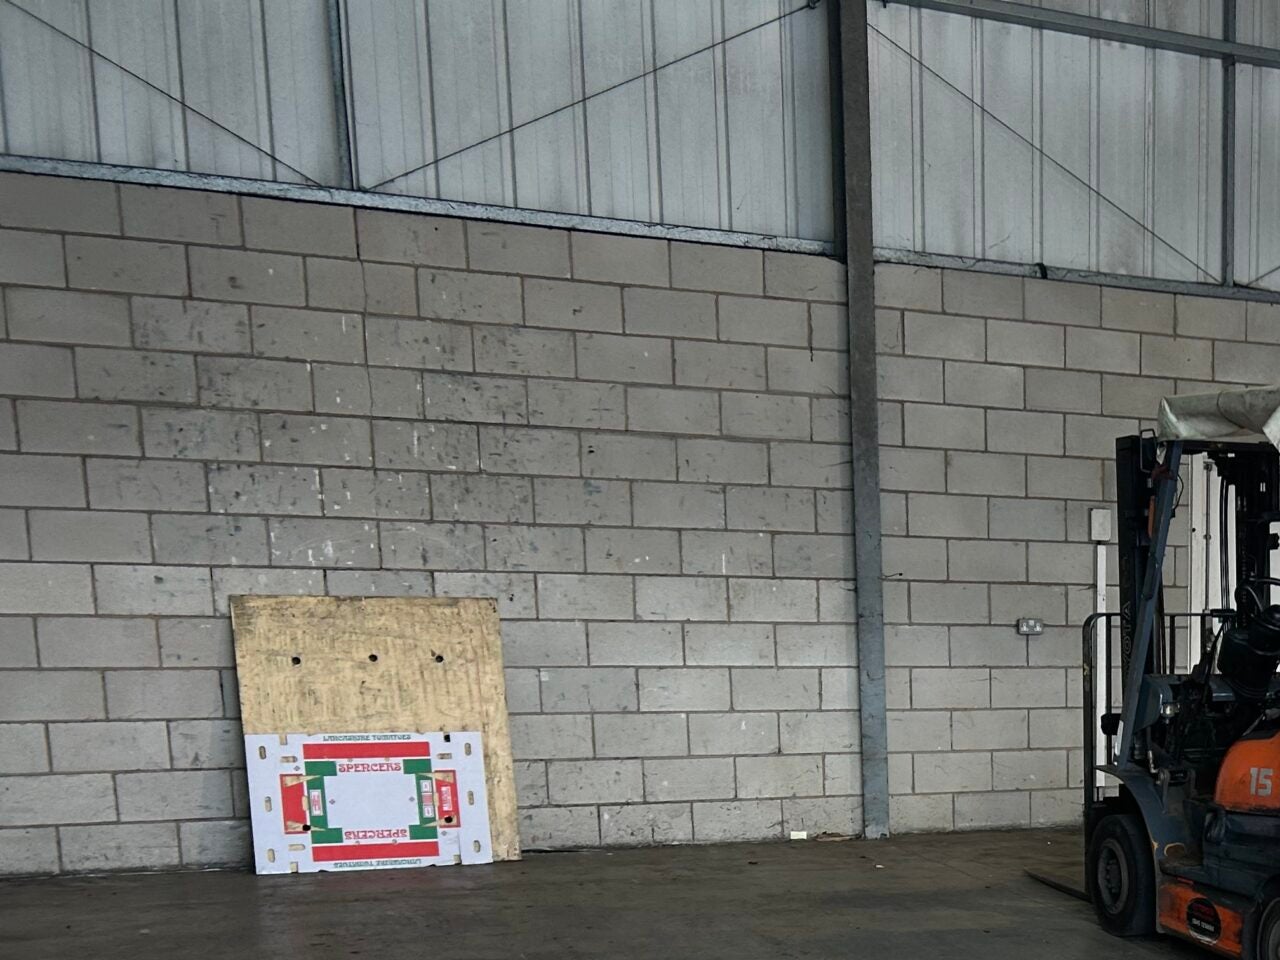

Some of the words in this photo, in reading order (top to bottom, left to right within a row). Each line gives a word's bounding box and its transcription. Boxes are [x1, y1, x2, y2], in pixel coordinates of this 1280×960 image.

[1121, 601, 1132, 669] YOTA
[338, 762, 402, 772] SPENCERS
[1250, 767, 1273, 797] 15
[344, 828, 408, 840] SPENCERS
